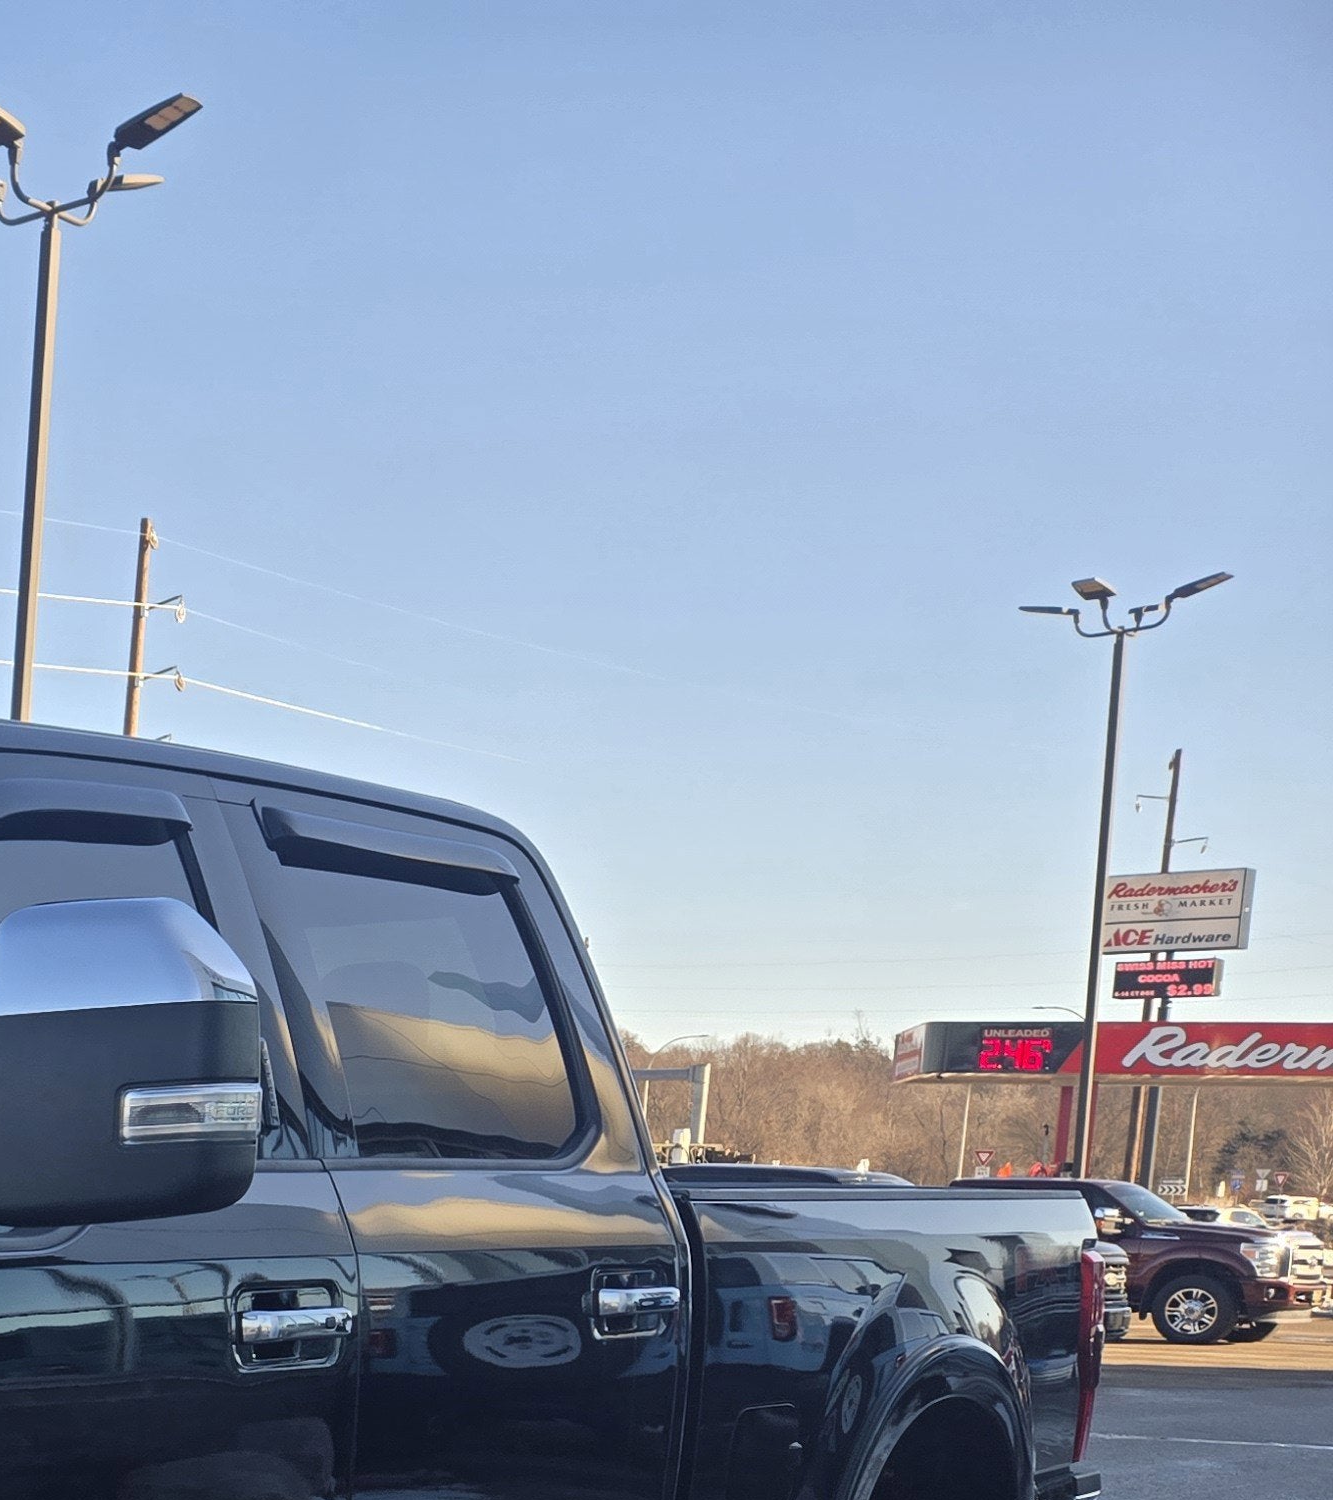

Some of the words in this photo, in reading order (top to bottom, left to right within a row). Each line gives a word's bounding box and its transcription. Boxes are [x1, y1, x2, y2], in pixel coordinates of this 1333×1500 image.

[1108, 879, 1239, 899] Radermacher's
[1110, 902, 1150, 911] FRESH
[1178, 898, 1232, 908] MARKET
[1104, 928, 1154, 947] ACE
[1153, 932, 1232, 945] Hardware
[1156, 961, 1186, 970] MISS
[1189, 960, 1214, 969] HOT
[1138, 974, 1180, 983] COCOA
[984, 1029, 1050, 1038] UNLEADED
